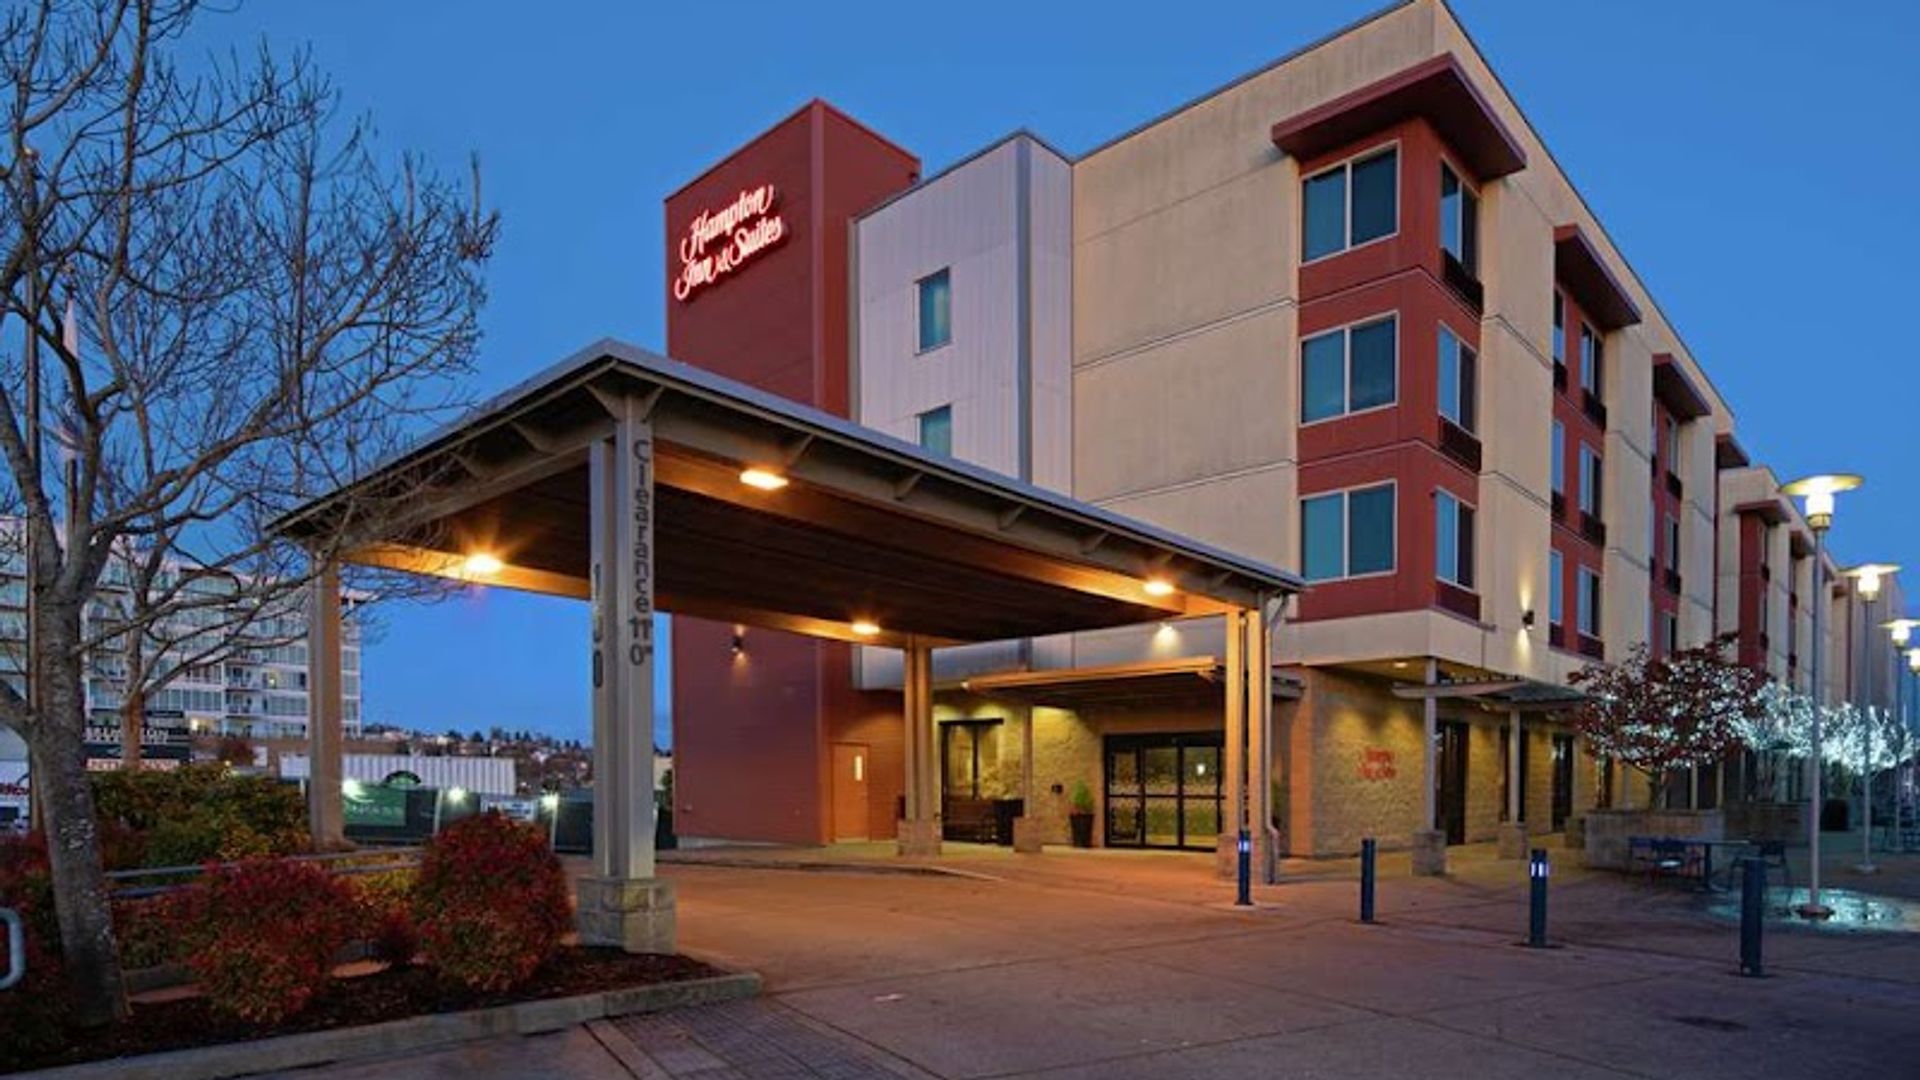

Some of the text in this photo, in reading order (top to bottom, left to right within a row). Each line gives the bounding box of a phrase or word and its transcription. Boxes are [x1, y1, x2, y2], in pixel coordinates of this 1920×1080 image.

[674, 216, 782, 301] Inn & Suites
[680, 184, 774, 263] Hampton
[633, 439, 650, 613] Clearance
